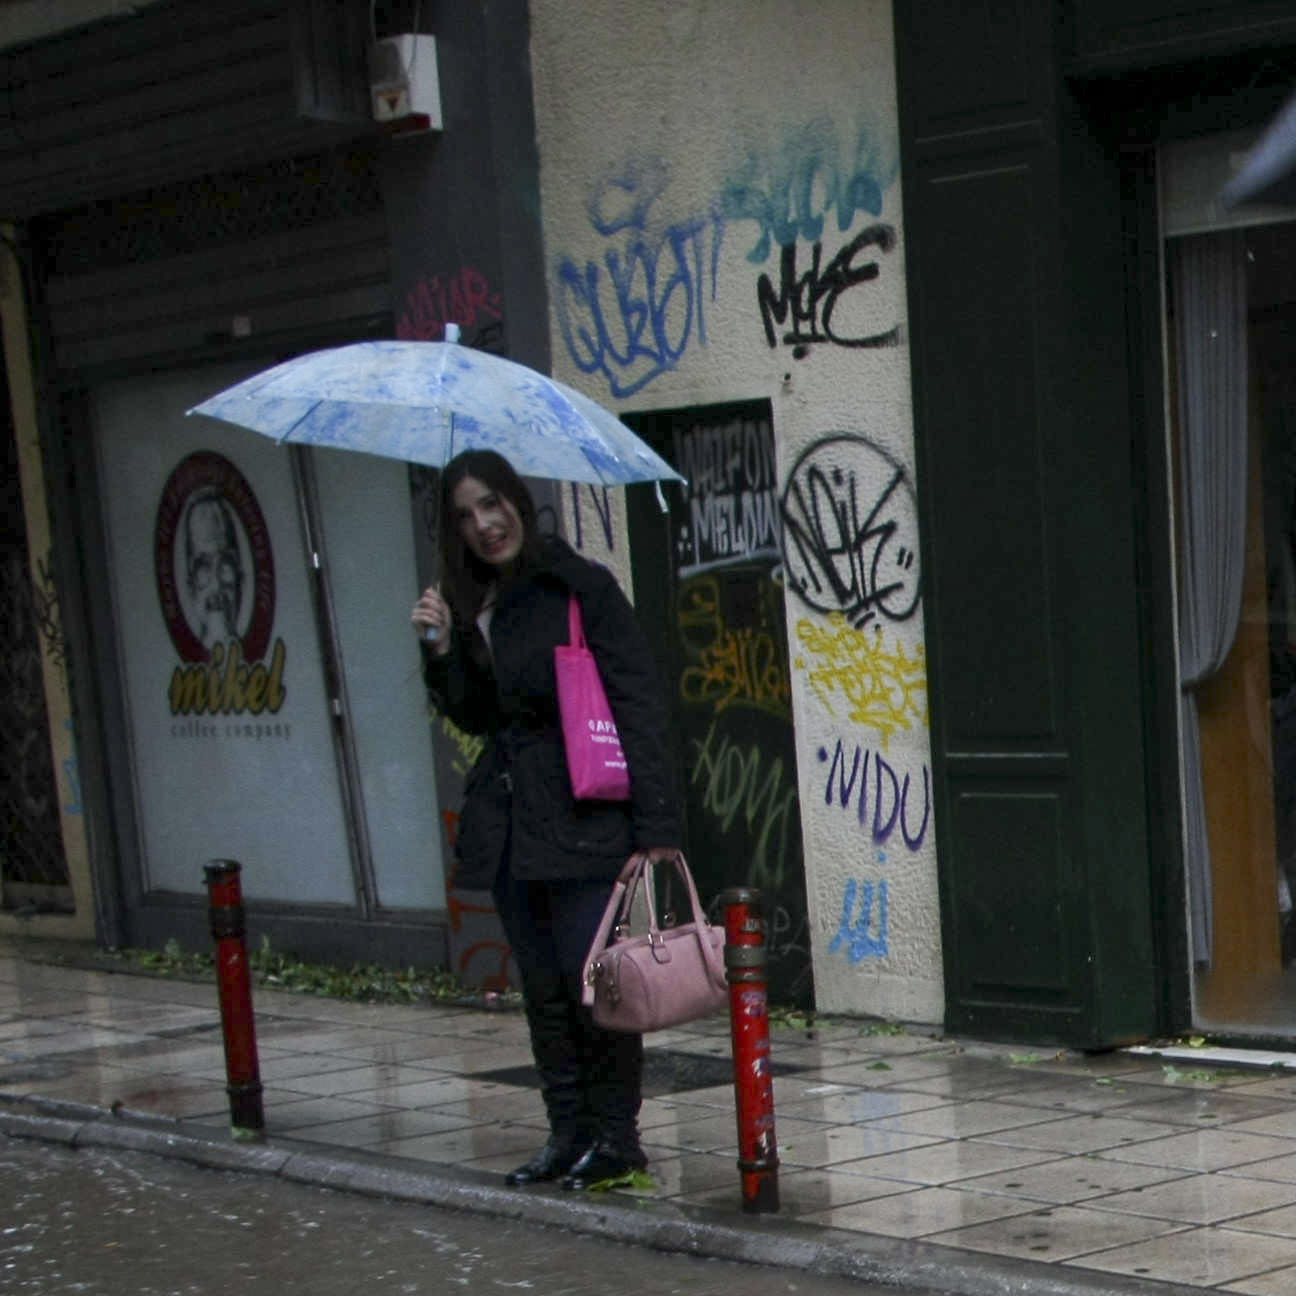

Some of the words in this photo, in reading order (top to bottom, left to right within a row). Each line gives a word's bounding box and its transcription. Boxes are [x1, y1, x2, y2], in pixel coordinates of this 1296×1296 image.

[168, 637, 287, 716] mikel
[170, 721, 217, 738] coffee
[225, 723, 292, 741] company
